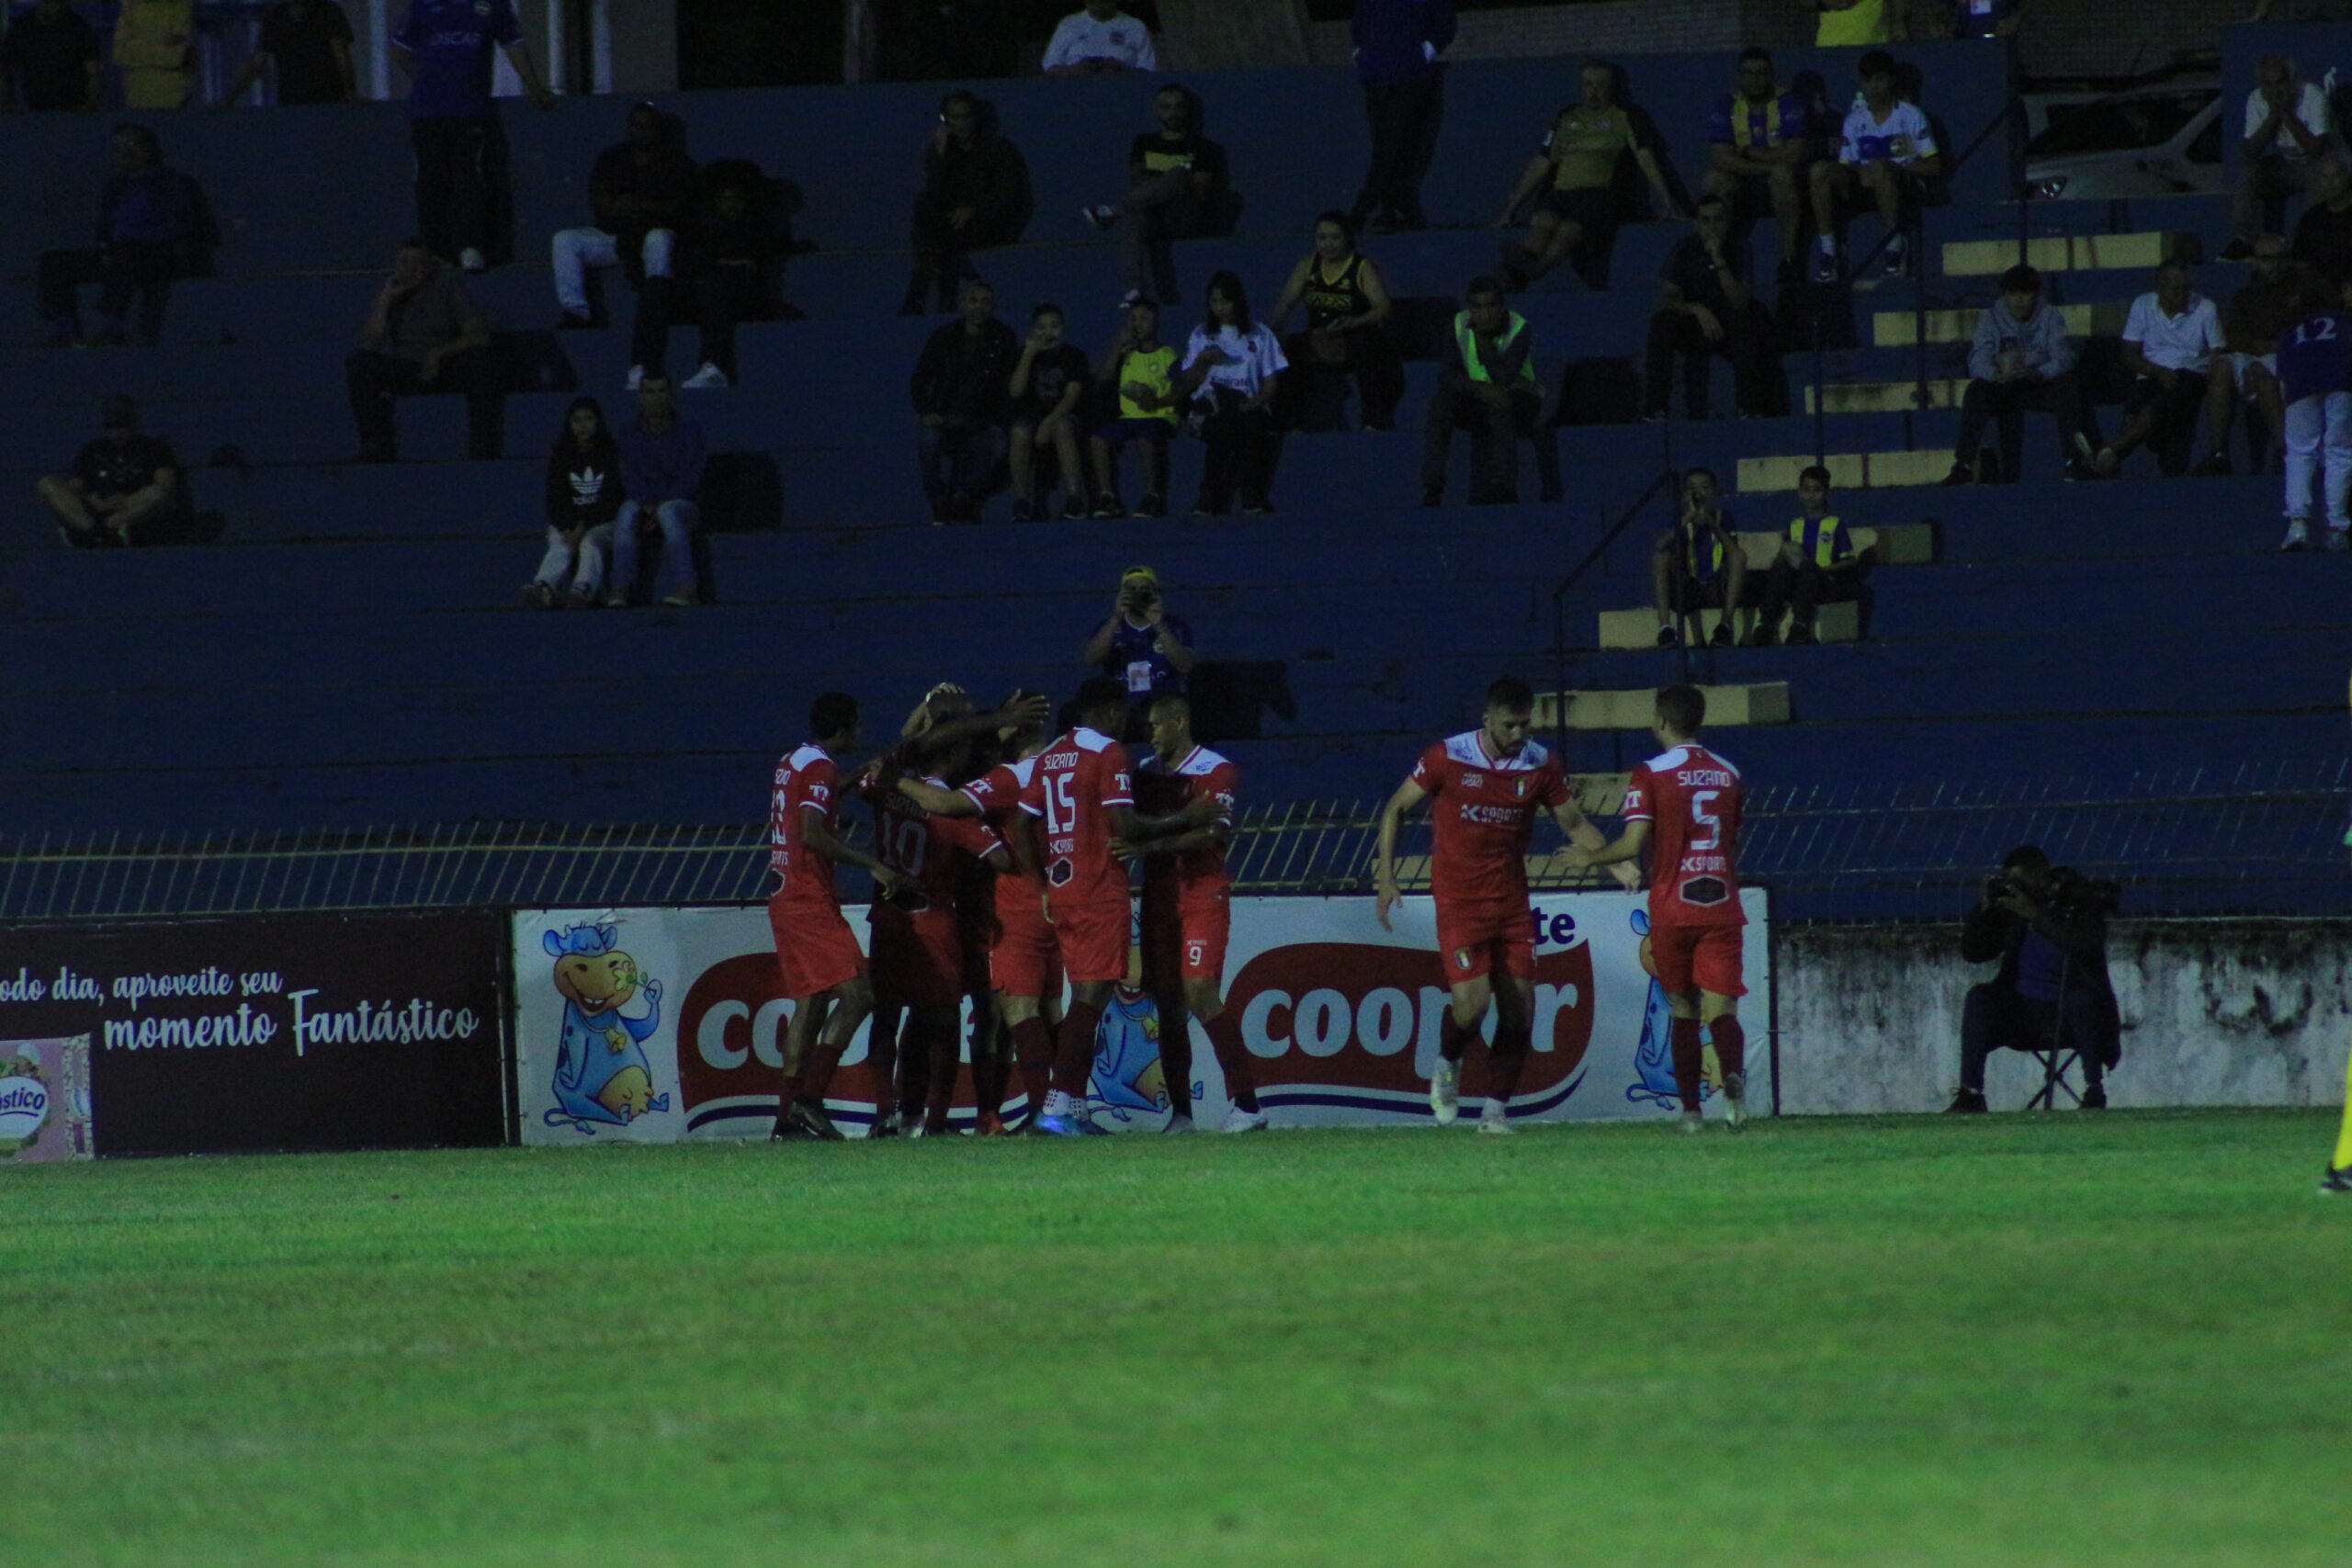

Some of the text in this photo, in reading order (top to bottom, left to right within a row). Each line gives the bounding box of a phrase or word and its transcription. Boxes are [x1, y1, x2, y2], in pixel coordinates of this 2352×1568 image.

[2296, 316, 2337, 345] 12
[1044, 752, 1079, 771] SUZANO
[1677, 771, 1732, 786] SUZANO
[1042, 773, 1076, 834] 15
[1690, 790, 1721, 851] 5
[881, 810, 927, 875] 10
[1189, 946, 1203, 966] 9
[52, 965, 105, 1007] dia,
[112, 965, 233, 1011] aproveite
[240, 971, 283, 997] seu
[104, 988, 480, 1056] momento Fantástico
[0, 1087, 45, 1110] stico
